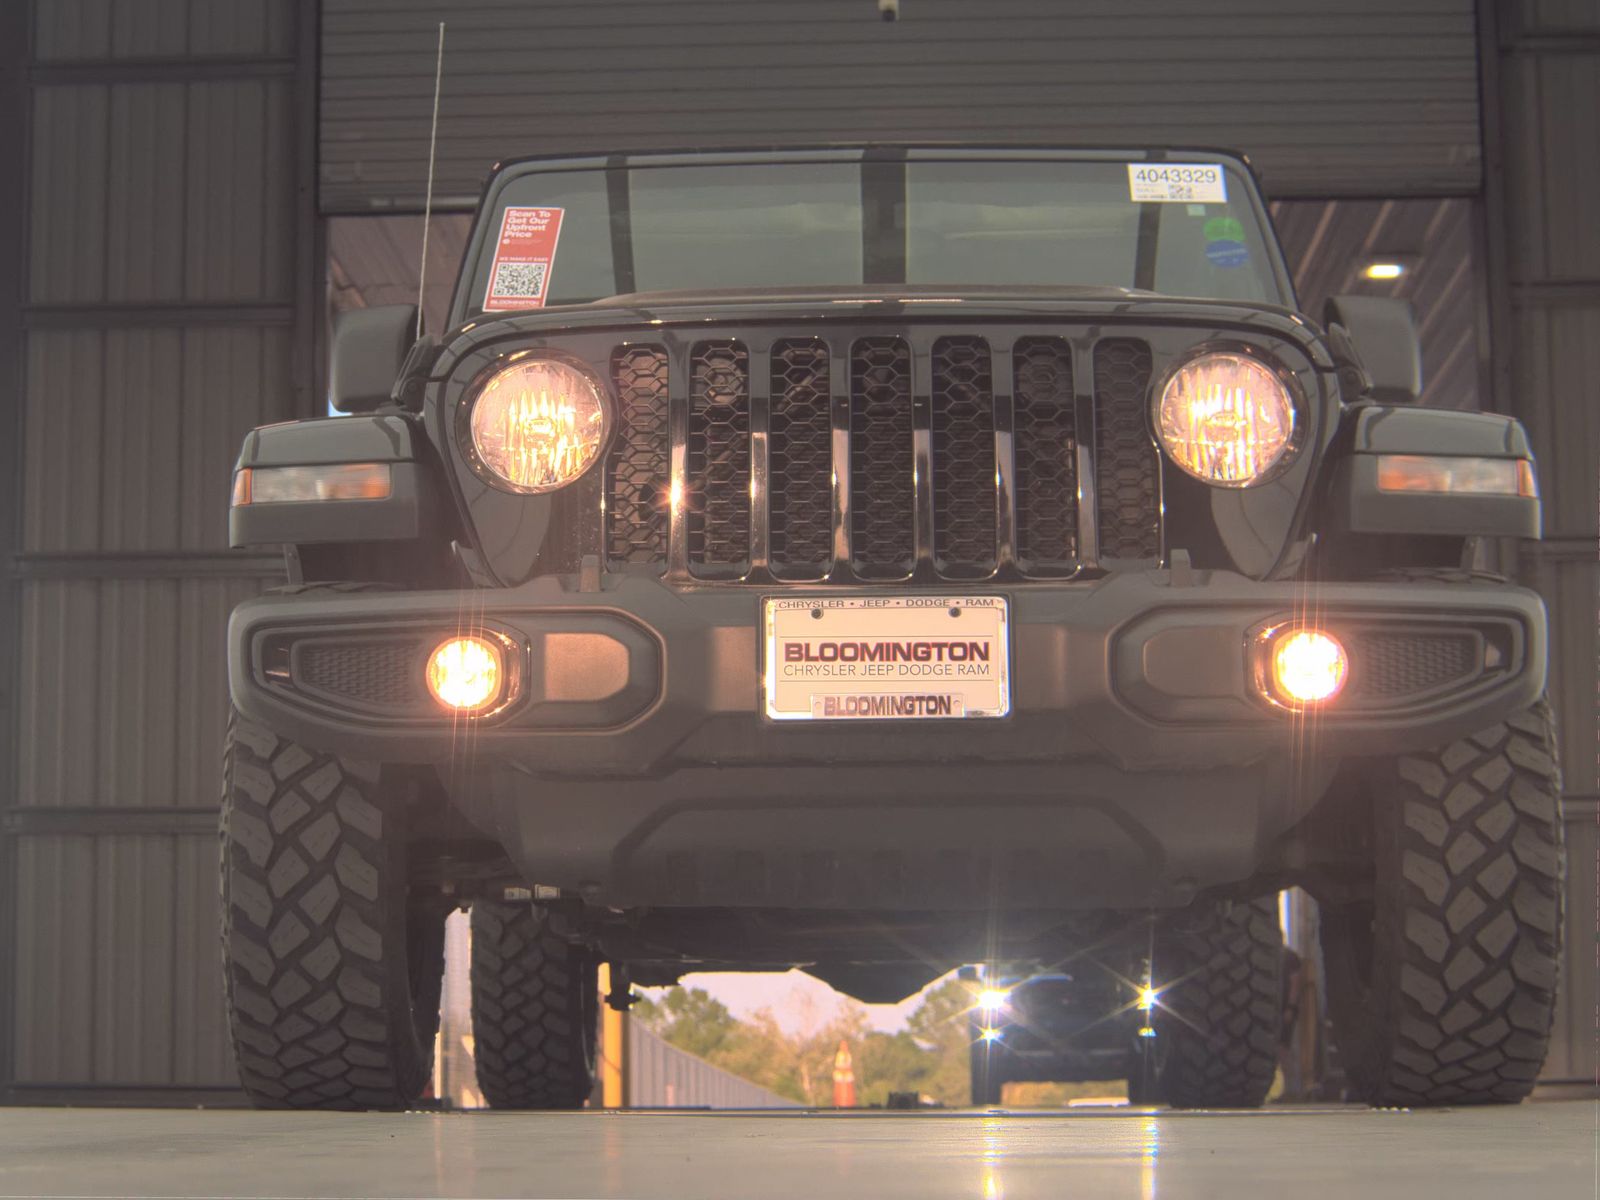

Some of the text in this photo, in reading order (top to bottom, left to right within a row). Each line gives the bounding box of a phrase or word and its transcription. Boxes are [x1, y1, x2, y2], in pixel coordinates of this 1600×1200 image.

[1136, 169, 1216, 183] 4043329
[506, 224, 546, 232] Upfront
[778, 598, 994, 609] CHRYSLER JEEP DODGE RAM
[784, 642, 990, 662] BLOOMINGTON
[784, 664, 990, 676] CHRYSLER JEEP DODGE RAM
[824, 695, 951, 716] BLOOMINGTON
